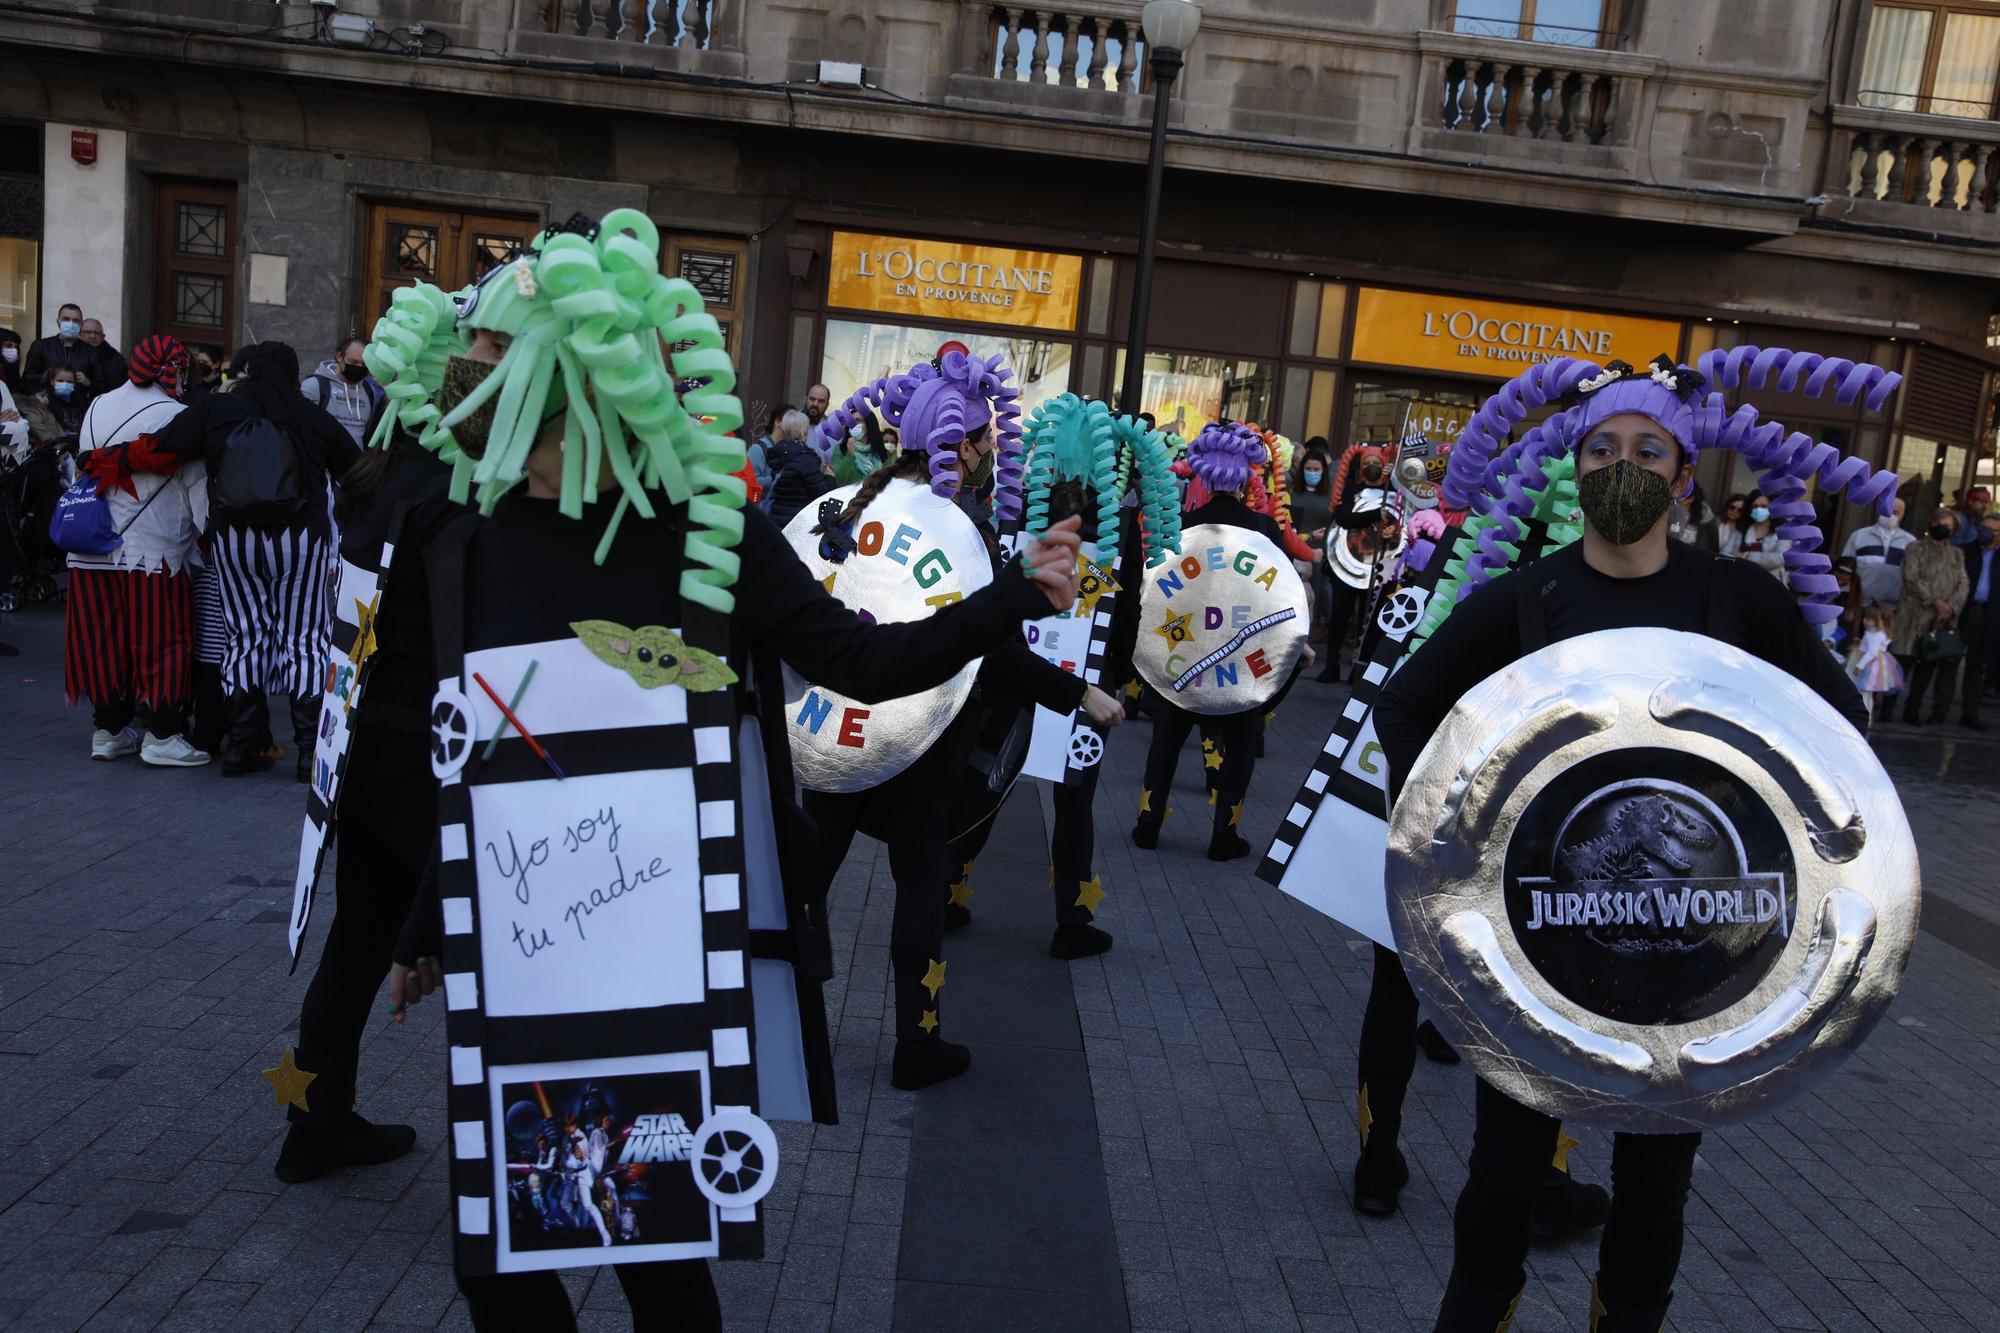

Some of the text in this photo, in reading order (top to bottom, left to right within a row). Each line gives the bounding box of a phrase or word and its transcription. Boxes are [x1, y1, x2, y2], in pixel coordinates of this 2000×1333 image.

[858, 249, 1054, 295] L'OCCITANE
[895, 283, 1013, 307] EN PROVENCE
[1422, 310, 1614, 356] L'OCCITANE
[1458, 344, 1567, 365] EN PROVEN
[842, 520, 963, 610] OEG
[1156, 546, 1278, 599] NOEGA
[1028, 625, 1060, 650] DE
[1205, 605, 1251, 630] DE
[796, 690, 870, 749] NE
[486, 805, 622, 905] Yo soy
[512, 854, 672, 958] tu padre
[1526, 887, 1779, 930] JURASSIC WORLD
[629, 1112, 692, 1136] STAR
[617, 1132, 696, 1165] WARS
